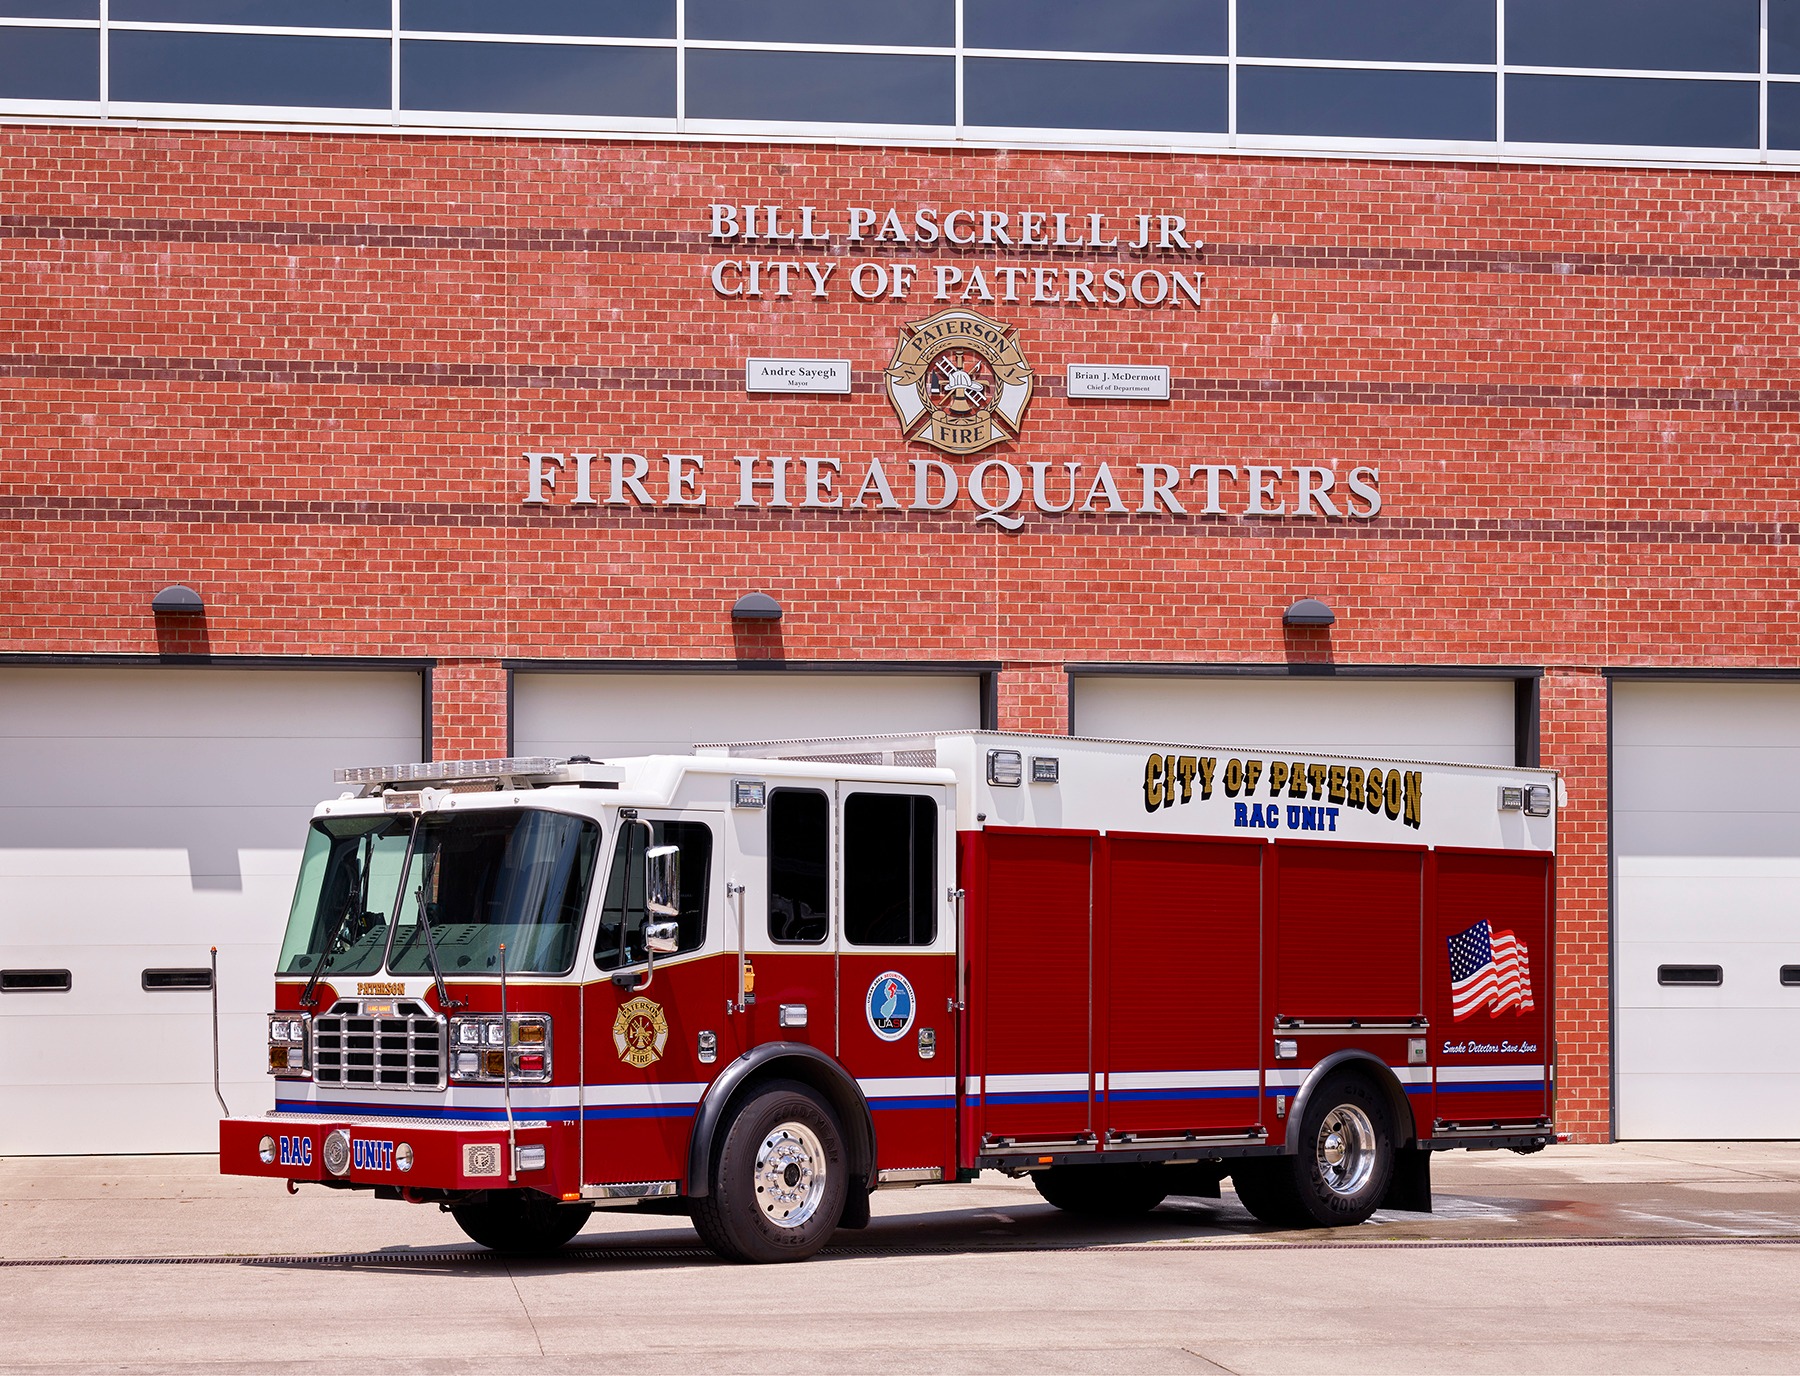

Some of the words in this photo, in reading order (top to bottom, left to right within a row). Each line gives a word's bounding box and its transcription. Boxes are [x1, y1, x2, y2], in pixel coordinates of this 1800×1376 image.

[708, 204, 830, 241] BILL
[846, 206, 1118, 248] PASCRELL
[1129, 214, 1204, 250] JR.
[711, 260, 837, 297] CITY
[850, 262, 917, 298] OF
[933, 265, 1205, 306] PATERSON
[911, 321, 1010, 353] PATERSON
[761, 367, 796, 376] Andre
[798, 367, 836, 379] Sayegh
[1075, 371, 1099, 380] Brian
[1102, 372, 1110, 382] J.
[1112, 372, 1161, 381] McDermott
[788, 380, 808, 388] Mayor
[940, 425, 985, 443] FIRE
[522, 452, 706, 506] FIRE
[733, 455, 1382, 530] HEADQUARTERS
[1143, 753, 1217, 813] CITY
[1223, 758, 1263, 798] OF
[1269, 760, 1422, 830] PATERSON
[1234, 802, 1279, 828] RAC
[1286, 804, 1339, 832] UNIT
[357, 982, 405, 996] PATERSON
[622, 1002, 658, 1018] PATERSON
[878, 1019, 902, 1028] UASI
[1442, 1040, 1466, 1053] Smoke
[1468, 1040, 1499, 1053] Detectors
[1500, 1040, 1518, 1053] Save
[1518, 1040, 1537, 1053] Lives
[632, 1053, 650, 1062] FIRE
[280, 1135, 312, 1166] RAC
[353, 1139, 393, 1171] UNIT
